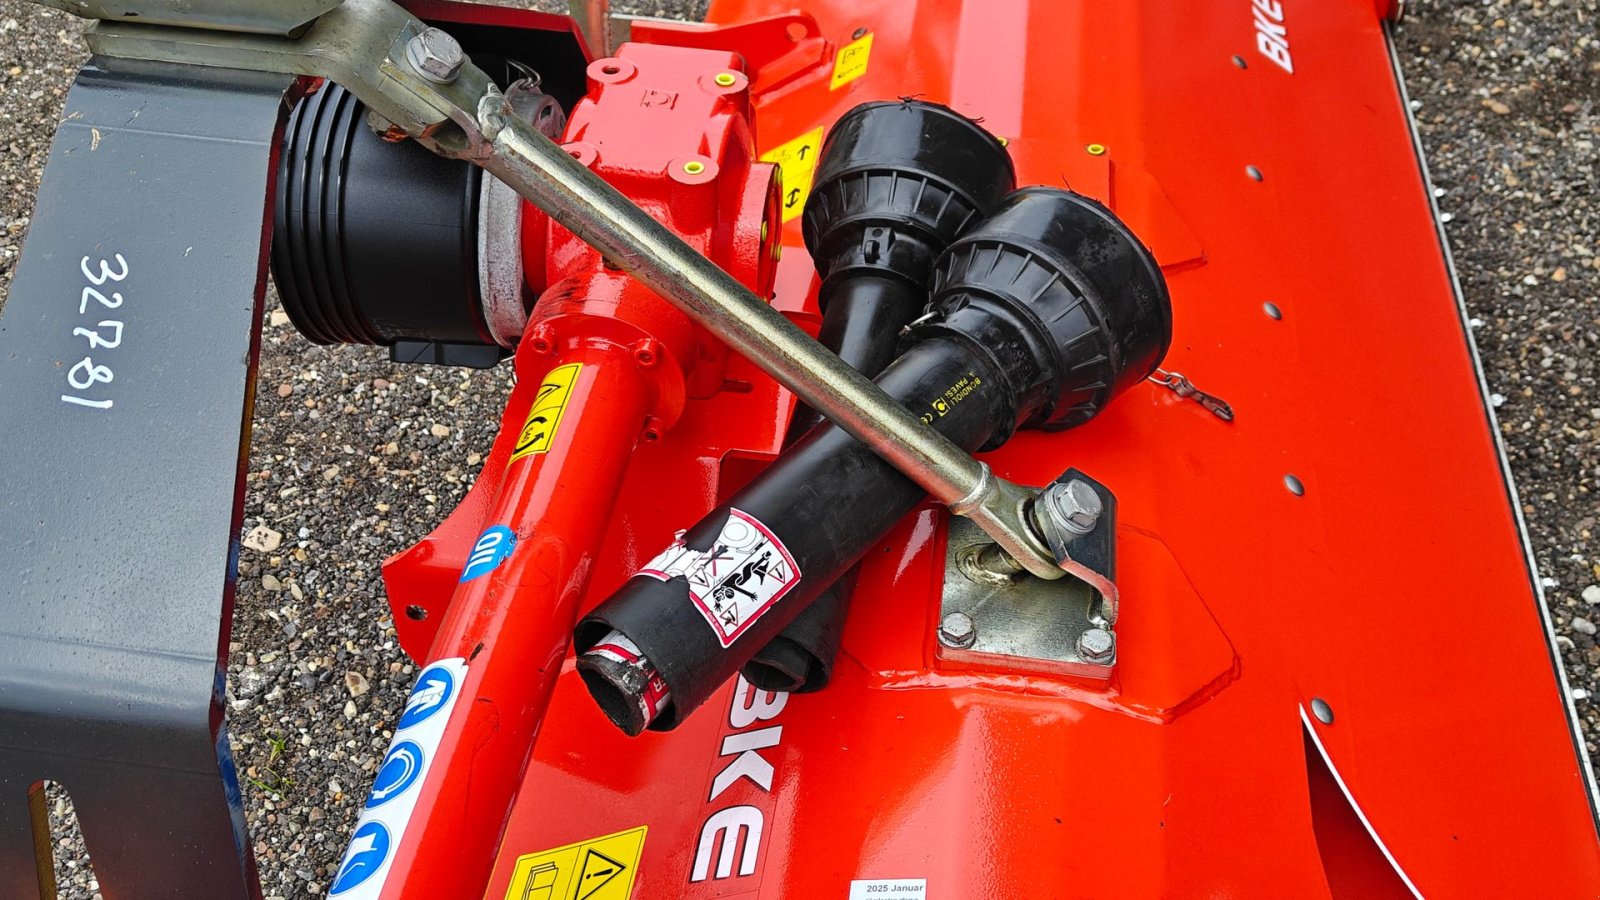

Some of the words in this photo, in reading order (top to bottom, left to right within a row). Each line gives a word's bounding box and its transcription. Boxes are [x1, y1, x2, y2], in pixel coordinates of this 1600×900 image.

[61, 253, 128, 408] 32781
[950, 377, 981, 406] BONDIOLI
[463, 532, 503, 578] OIL
[690, 673, 790, 882] BKE
[866, 884, 889, 893] 2025
[891, 884, 924, 892] Januar
